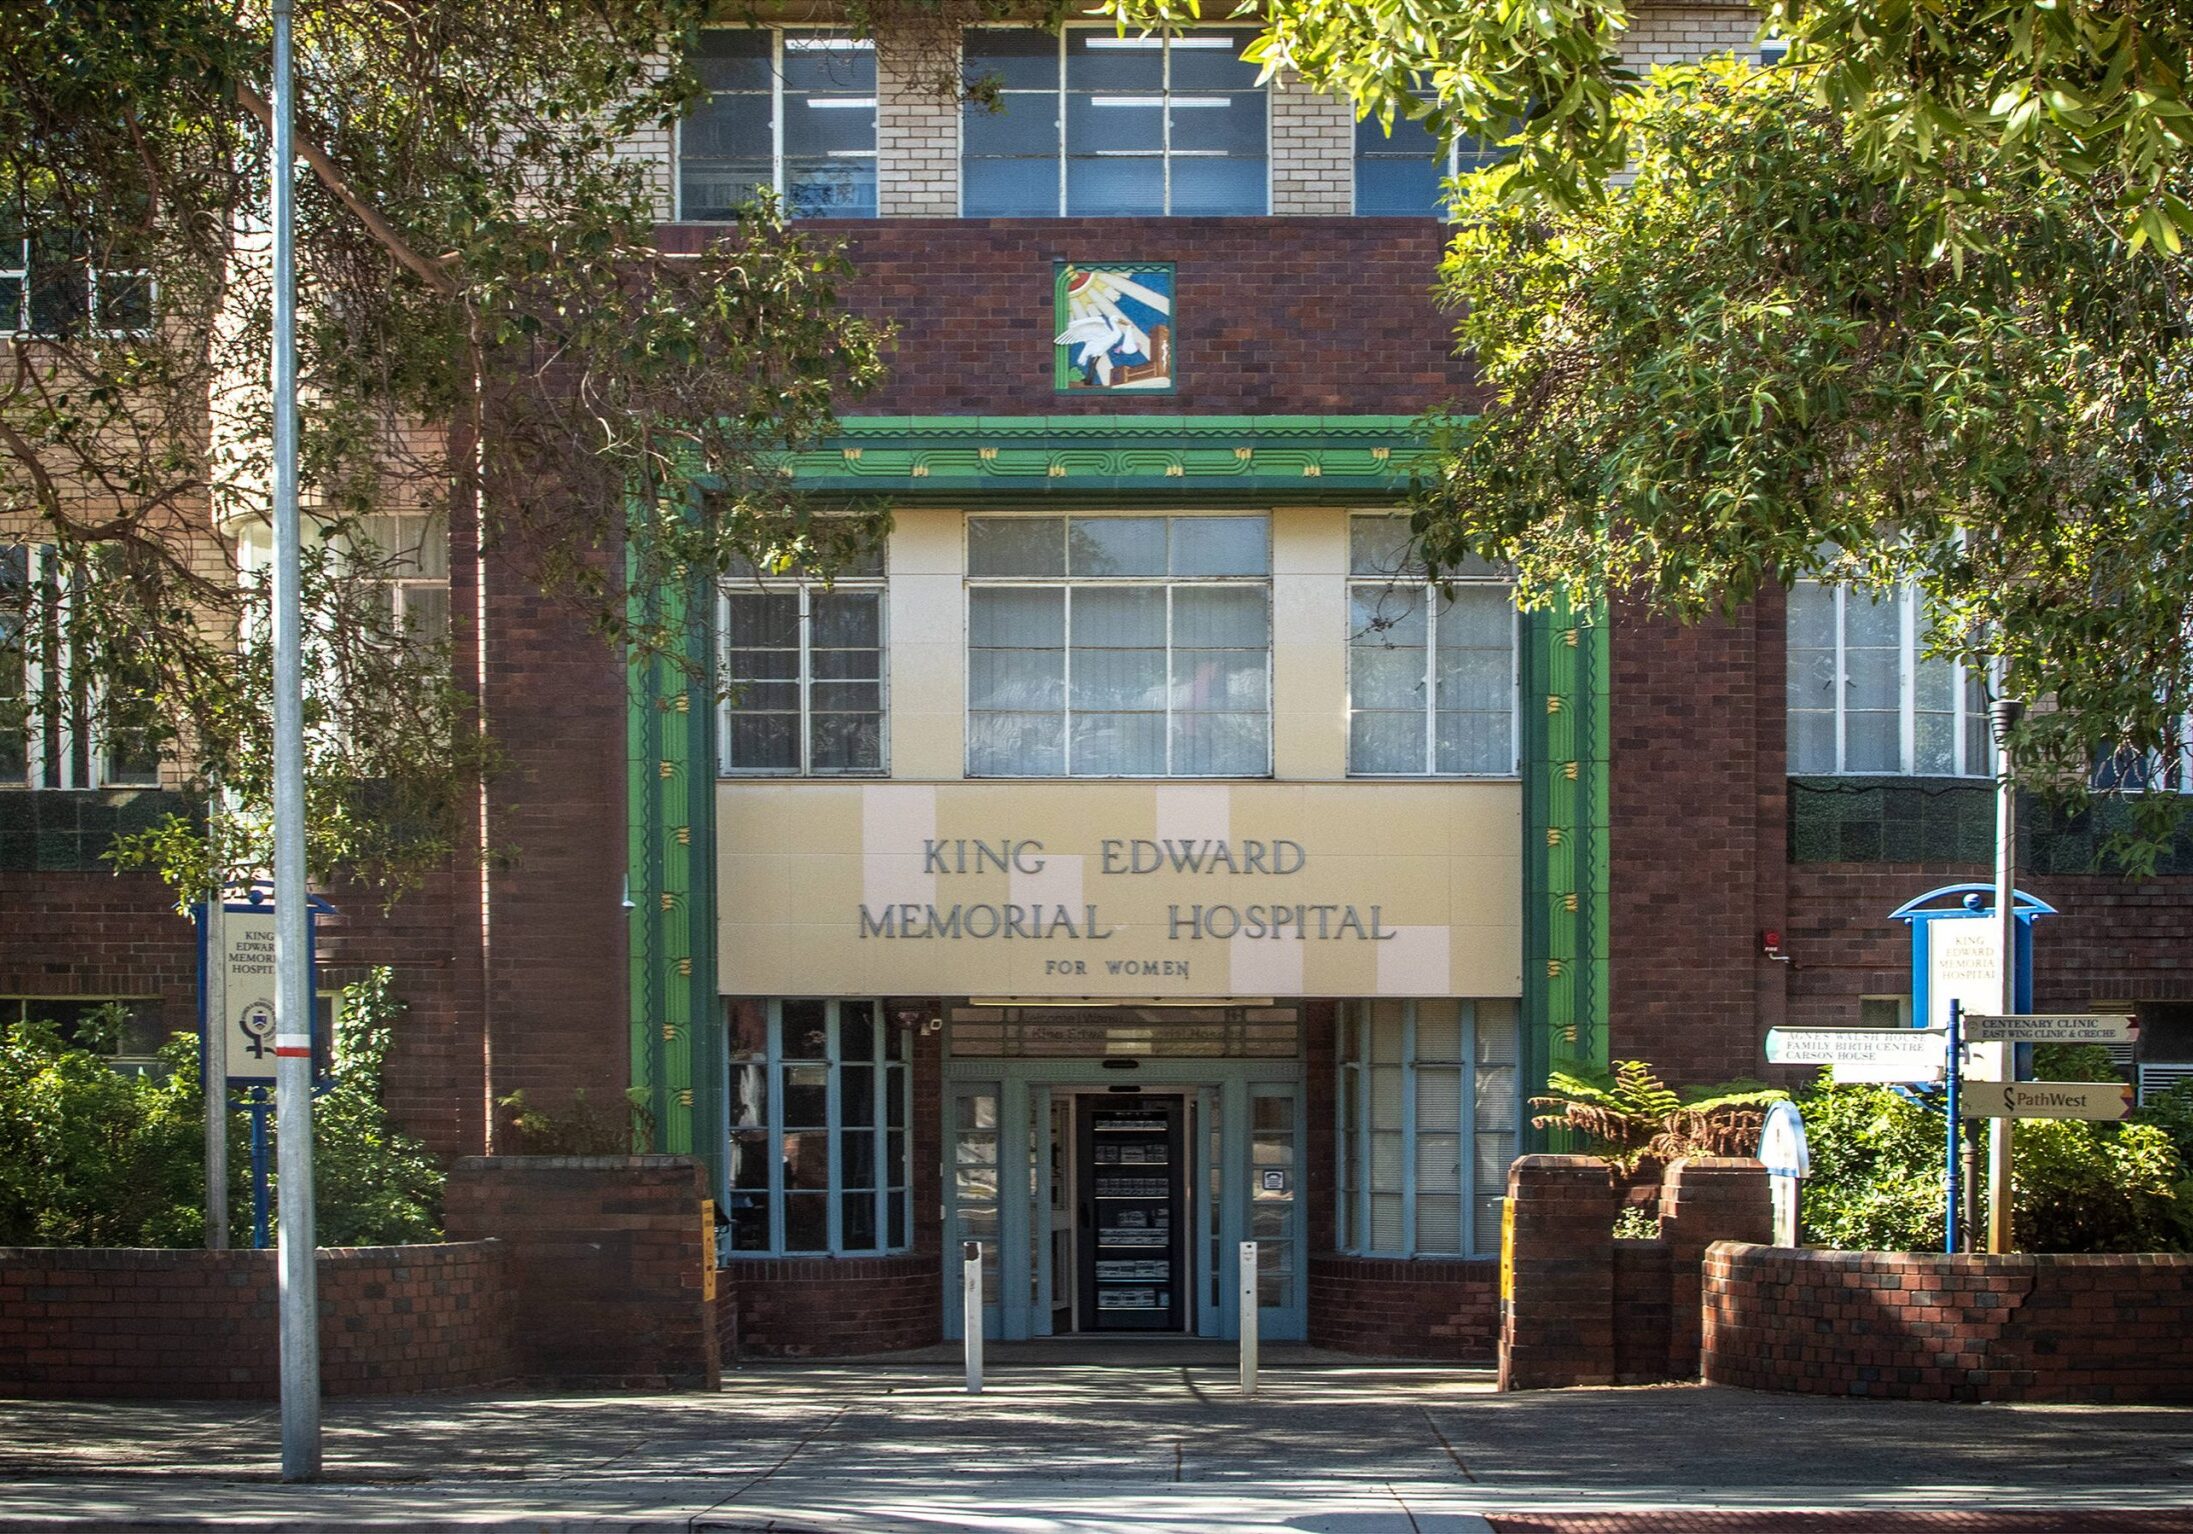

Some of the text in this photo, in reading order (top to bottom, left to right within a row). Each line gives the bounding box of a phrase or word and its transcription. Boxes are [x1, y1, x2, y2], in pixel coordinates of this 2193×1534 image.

[923, 839, 1306, 874] KING EDWARD
[858, 904, 1397, 940] MEMORIAL HOSPITAL
[245, 931, 275, 941] KING
[1955, 936, 1985, 945] KING
[236, 942, 275, 952] EDWAR
[1946, 947, 1994, 957] EDWARD
[1939, 959, 1996, 968] MEMORIA
[232, 964, 275, 974] HOSPIT
[1045, 960, 1190, 978] FOR WOMEN
[1982, 1019, 2098, 1028] CENTENARY CLINIC
[1982, 1030, 2116, 1038] EAST WING CLINIC & CRECHE
[1786, 1041, 1925, 1052] FAMILY BIRTH CENTRE
[1786, 1051, 1876, 1061] CARSON HOUSE
[2016, 1092, 2087, 1107] PathWest
